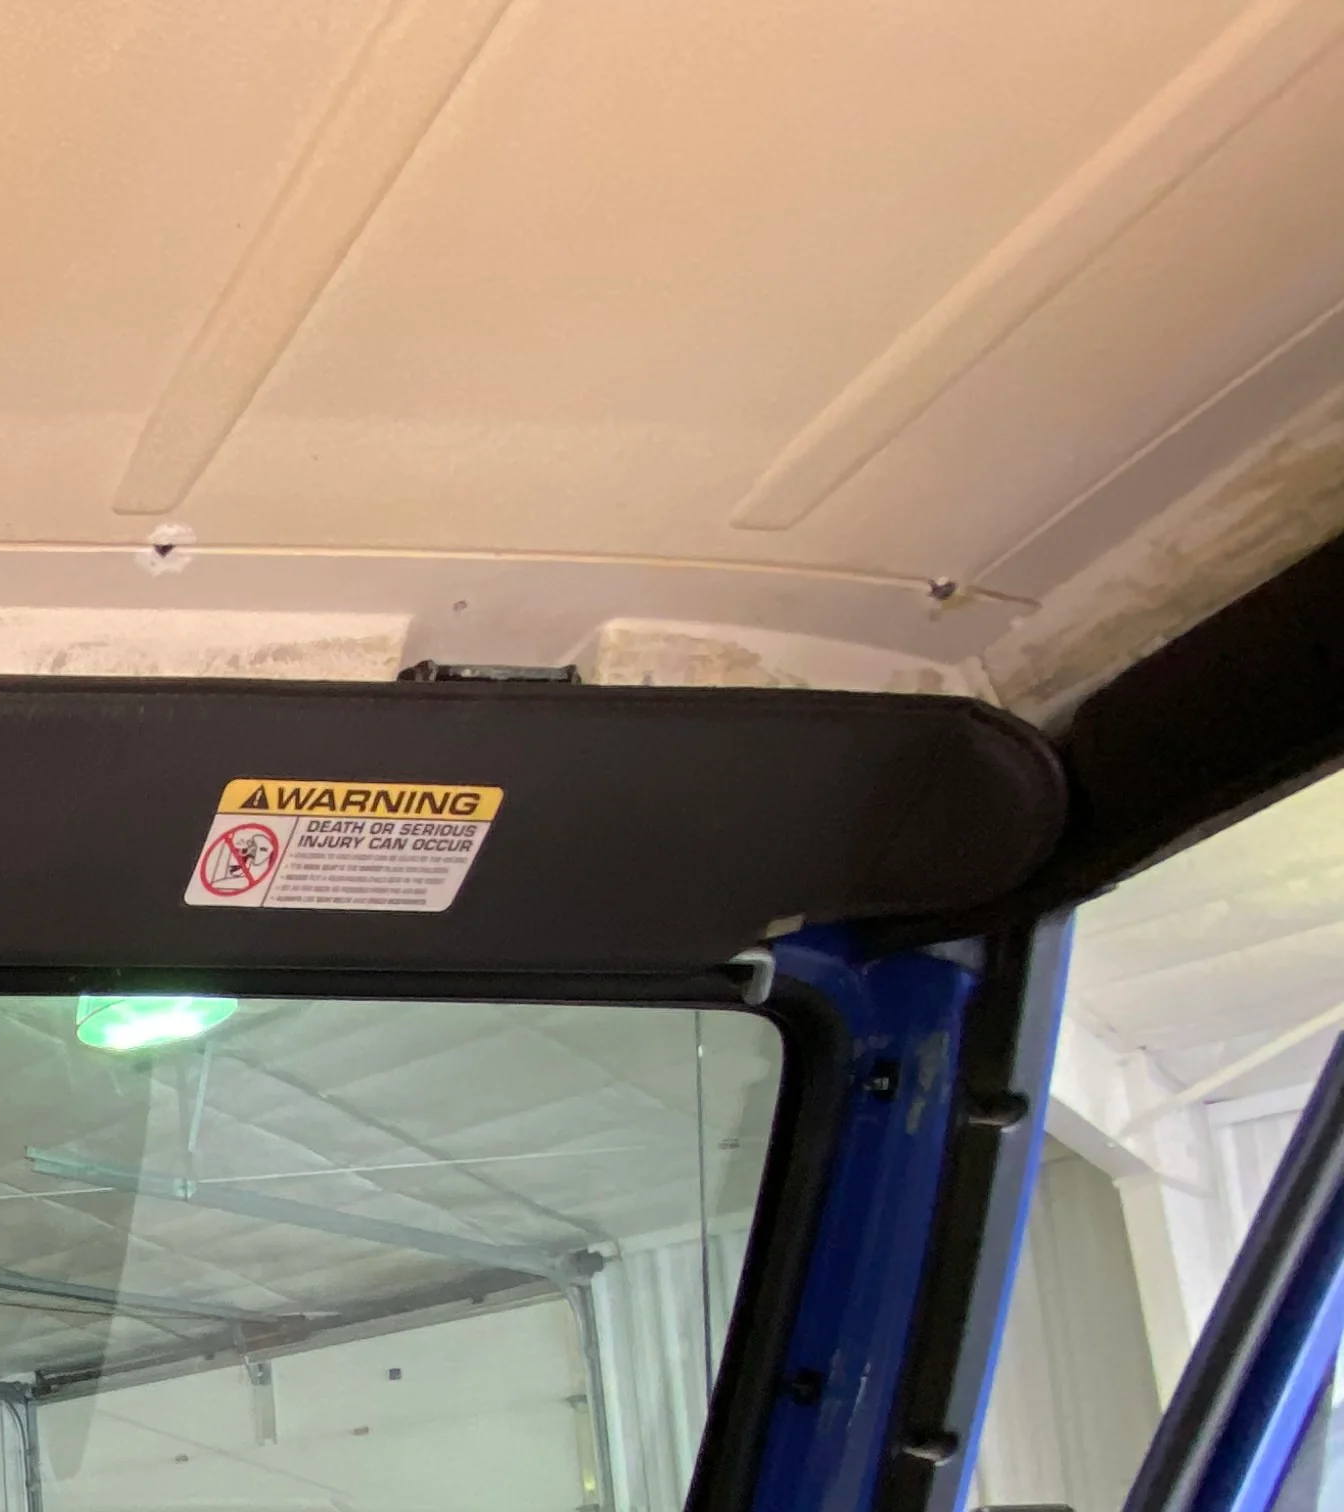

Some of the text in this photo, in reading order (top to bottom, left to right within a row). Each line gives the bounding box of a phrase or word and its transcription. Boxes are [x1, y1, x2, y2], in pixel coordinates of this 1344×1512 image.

[277, 787, 481, 816] WARNING
[307, 820, 477, 837] DEATH OR SERIOUS
[297, 835, 473, 852] INJURY CAN OCCUR
